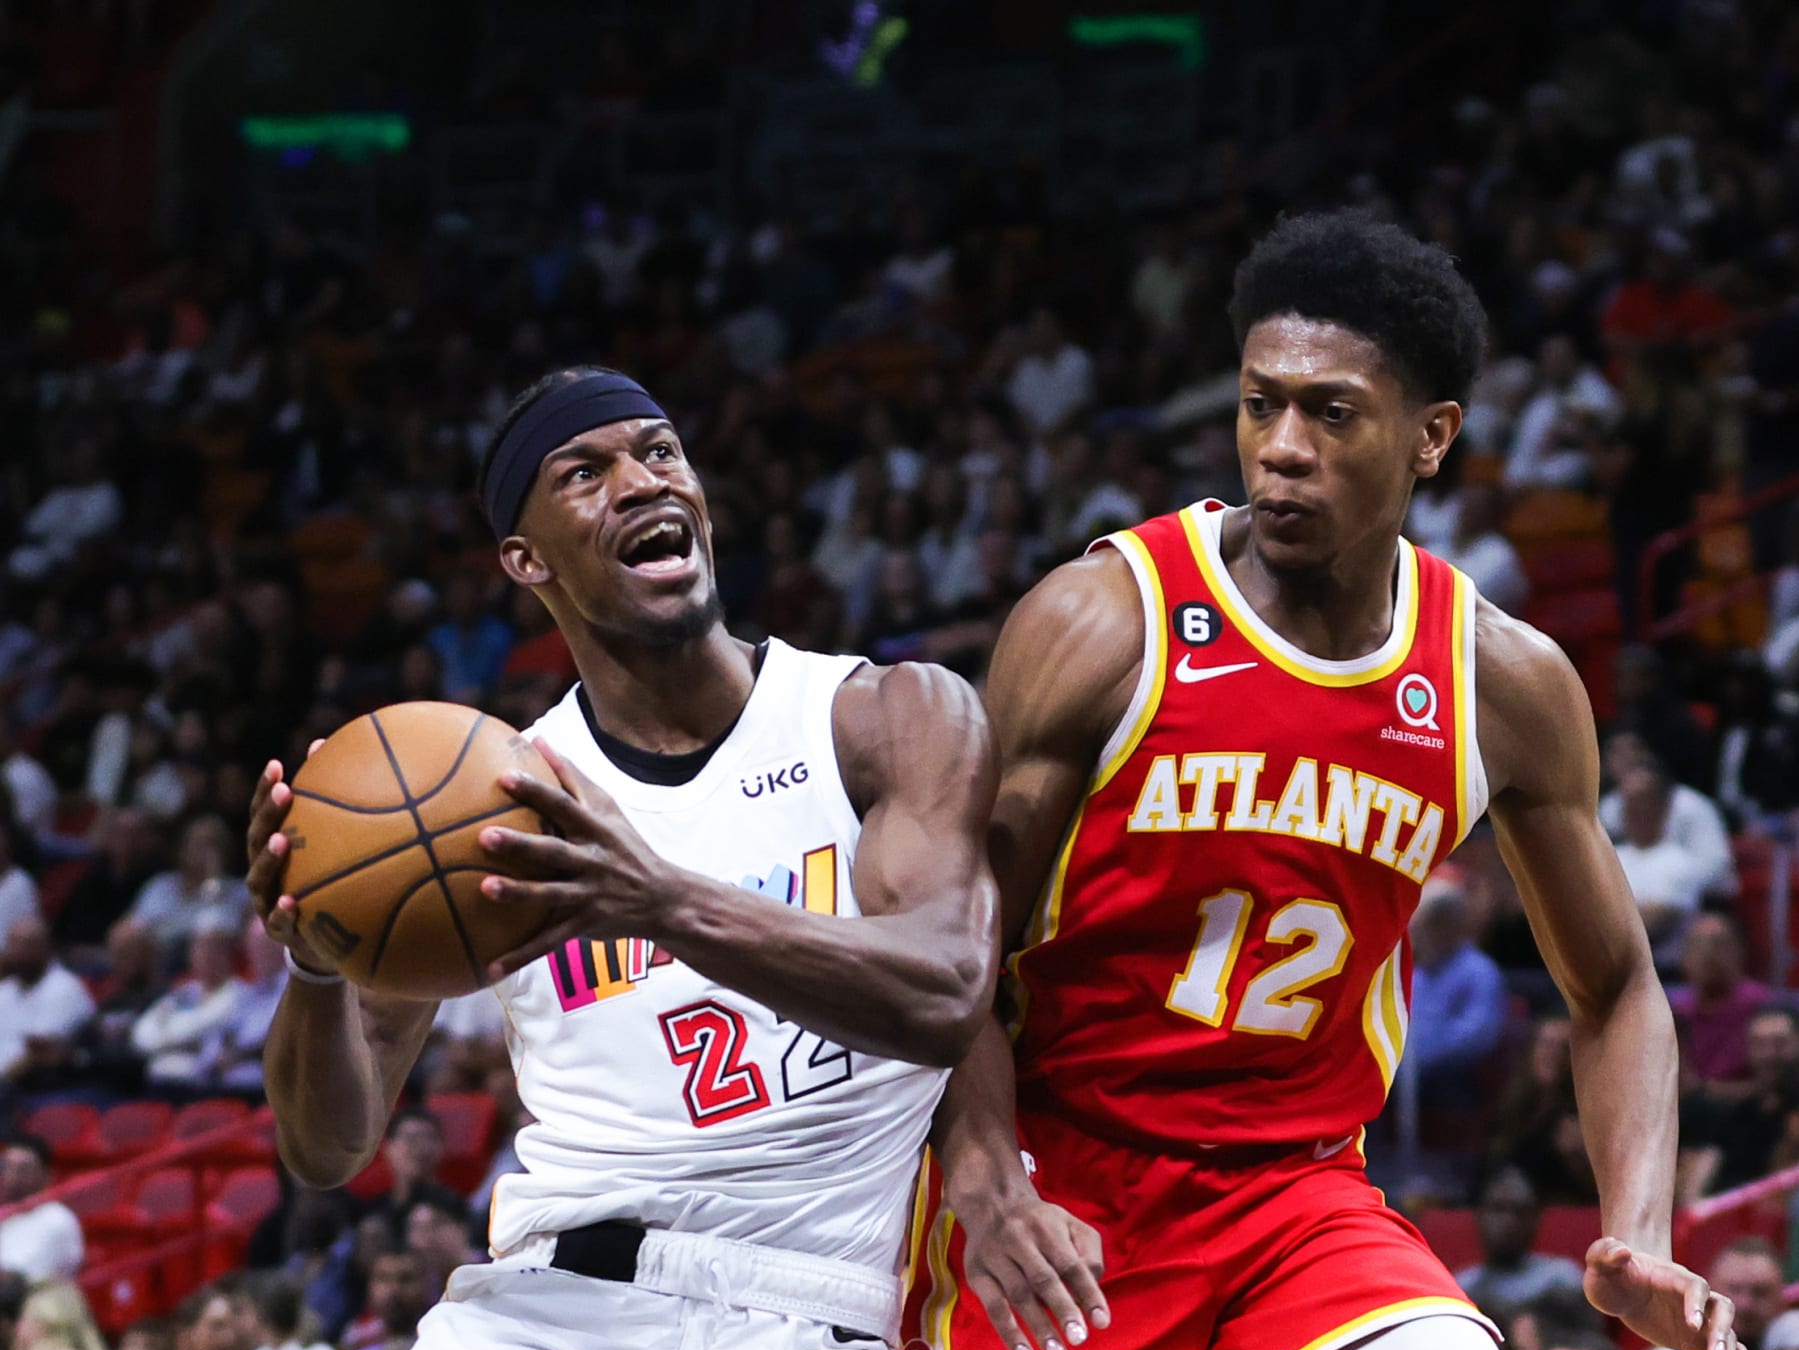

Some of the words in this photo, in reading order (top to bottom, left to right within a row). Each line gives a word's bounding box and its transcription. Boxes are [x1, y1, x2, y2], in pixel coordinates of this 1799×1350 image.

[1182, 607, 1210, 642] 6
[1380, 725, 1445, 750] sharecare
[1127, 751, 1444, 885] ATLANTA
[1164, 888, 1354, 1041] 12
